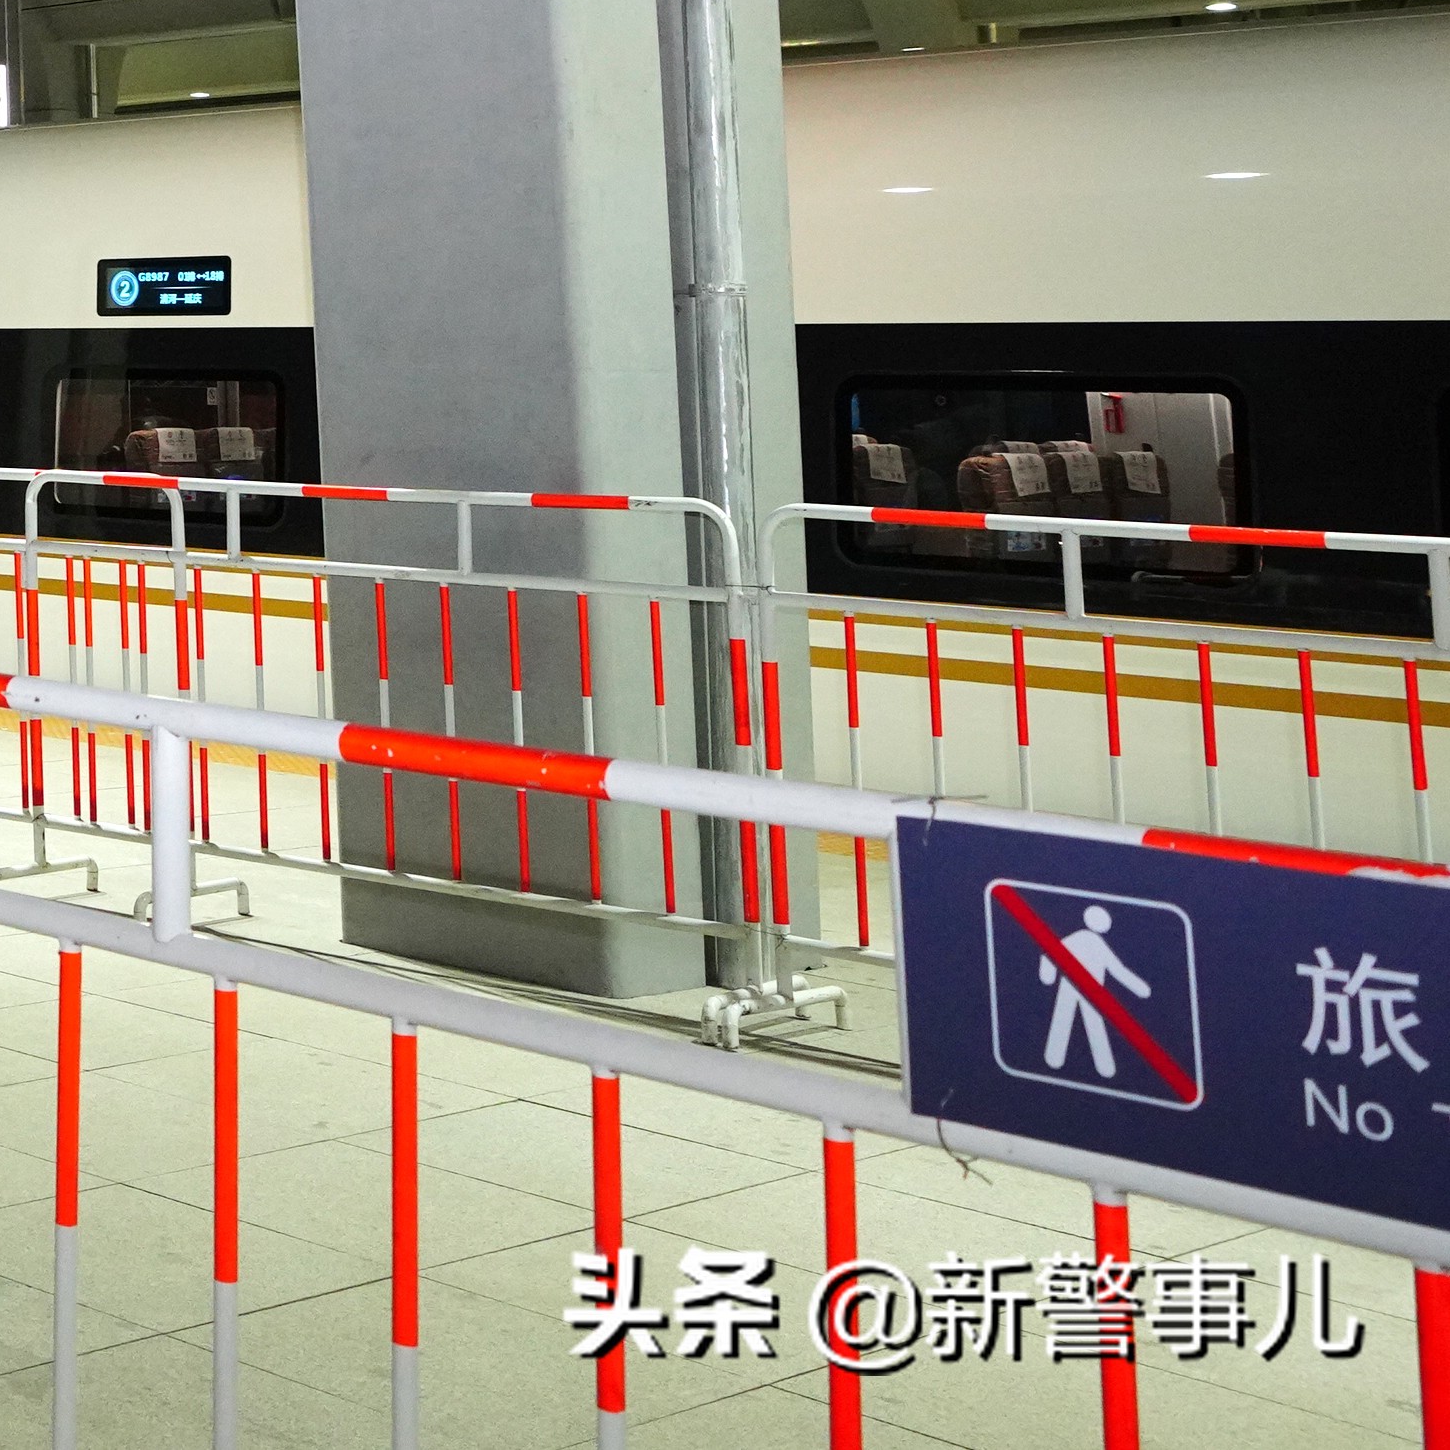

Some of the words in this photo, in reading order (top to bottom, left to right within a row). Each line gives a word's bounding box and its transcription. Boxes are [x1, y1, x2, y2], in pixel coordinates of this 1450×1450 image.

[120, 281, 131, 298] 2
[138, 271, 170, 282] G8987
[1295, 946, 1431, 1074] 旅
[1303, 1077, 1395, 1142] No
